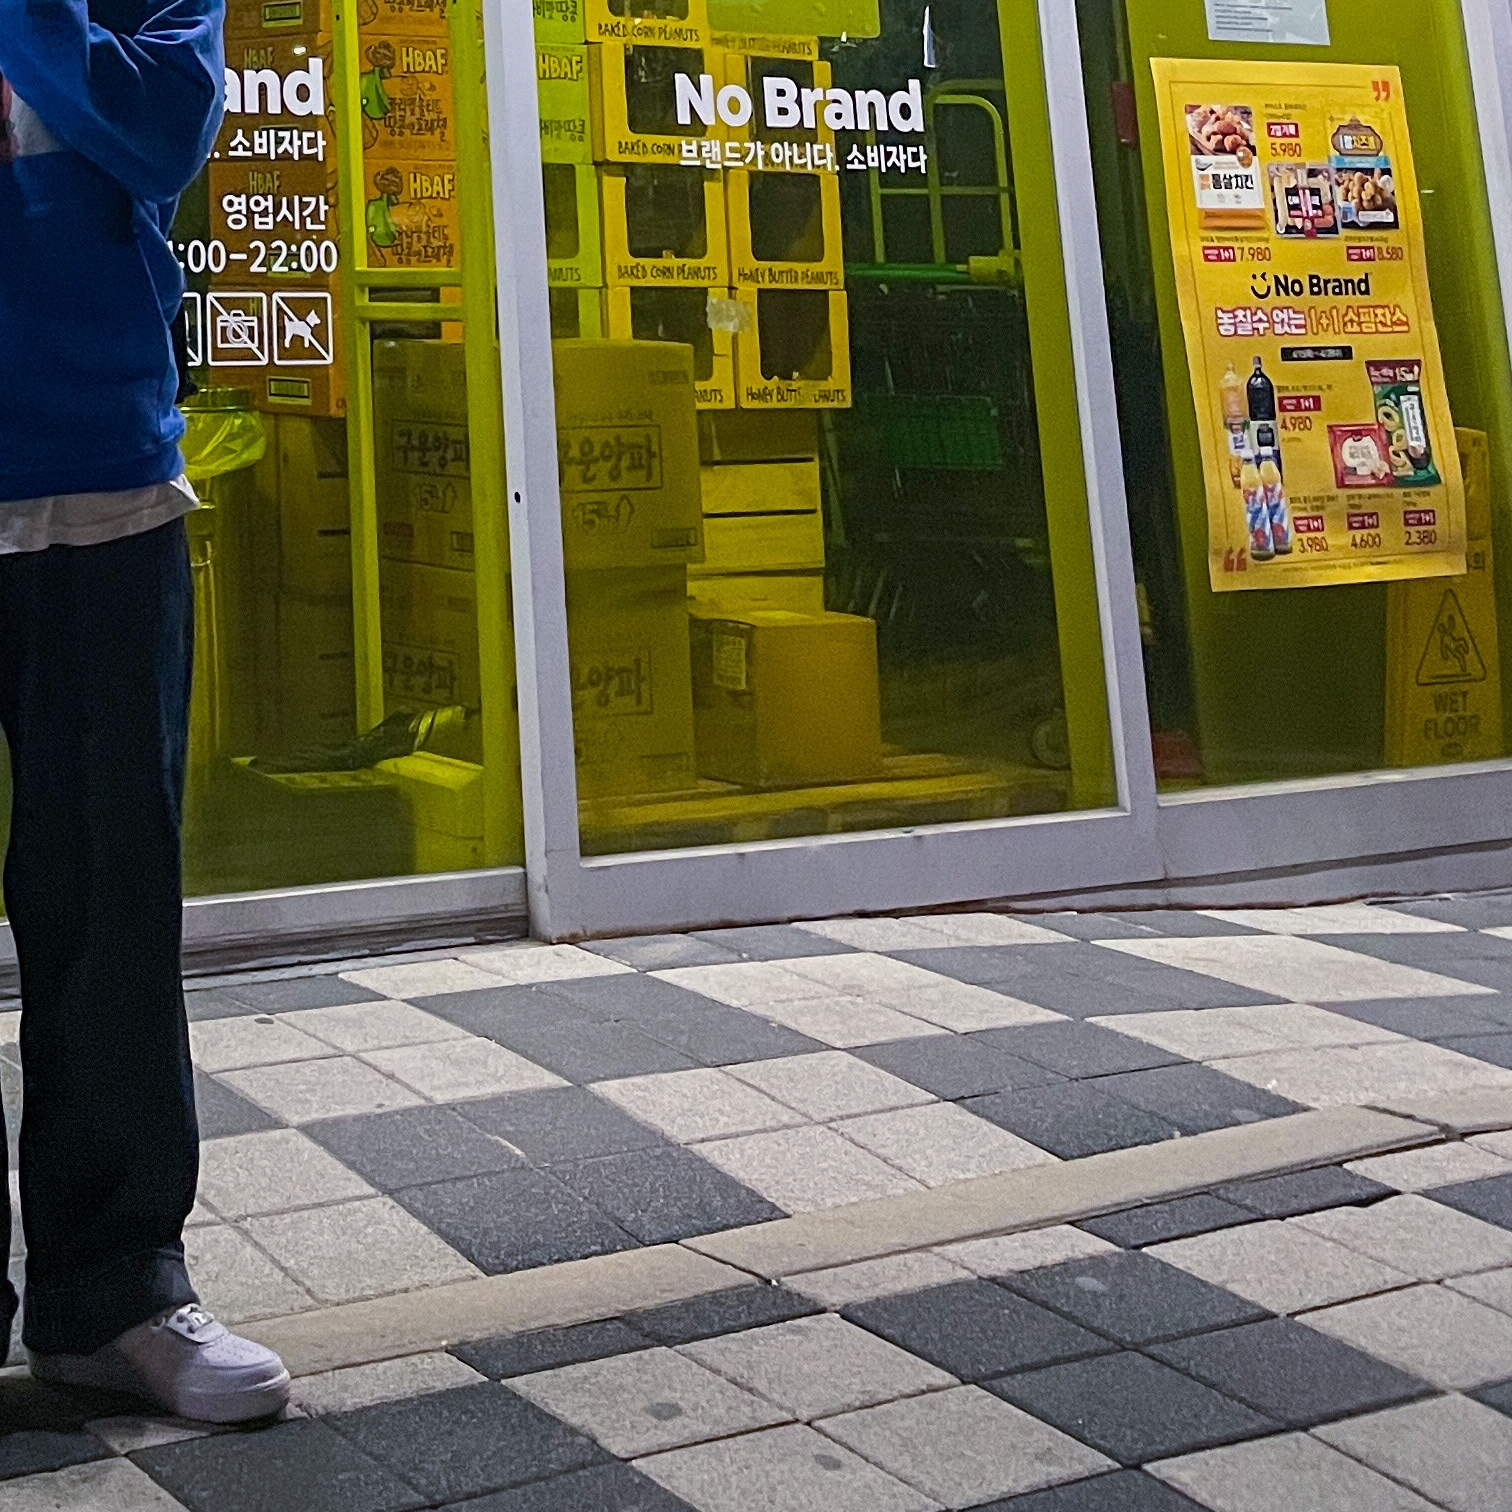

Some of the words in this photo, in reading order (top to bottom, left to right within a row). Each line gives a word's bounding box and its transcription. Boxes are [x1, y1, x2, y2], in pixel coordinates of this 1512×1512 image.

[598, 21, 627, 37] BAKED
[632, 24, 656, 38] CORN
[658, 24, 700, 42] PEANUTS
[401, 46, 449, 75] HBAF
[538, 54, 583, 81] HBAF
[674, 73, 753, 127] No
[762, 75, 925, 133] Brand
[228, 129, 326, 162] 소비자다
[618, 140, 648, 155] BAKED
[651, 143, 675, 156] CORN
[679, 141, 765, 170] 브랜드가
[770, 142, 840, 171] 아니다.
[845, 144, 928, 174] 소비자다
[409, 172, 455, 200] HBAF
[222, 194, 329, 230] 영업시간
[617, 262, 648, 280] BAKED
[650, 265, 675, 279] CORN
[677, 265, 718, 281] PEANUTS
[738, 267, 766, 282] HONEY
[768, 268, 798, 283] BUTTER
[801, 269, 839, 285] PEANUTS
[1273, 273, 1304, 297] No
[1308, 272, 1371, 296] Brand
[1271, 306, 1307, 336] 없는
[1308, 305, 1339, 335] 1+1
[746, 386, 774, 401] HONEY
[1433, 690, 1469, 714] WET
[1424, 714, 1481, 740] FLOOR
